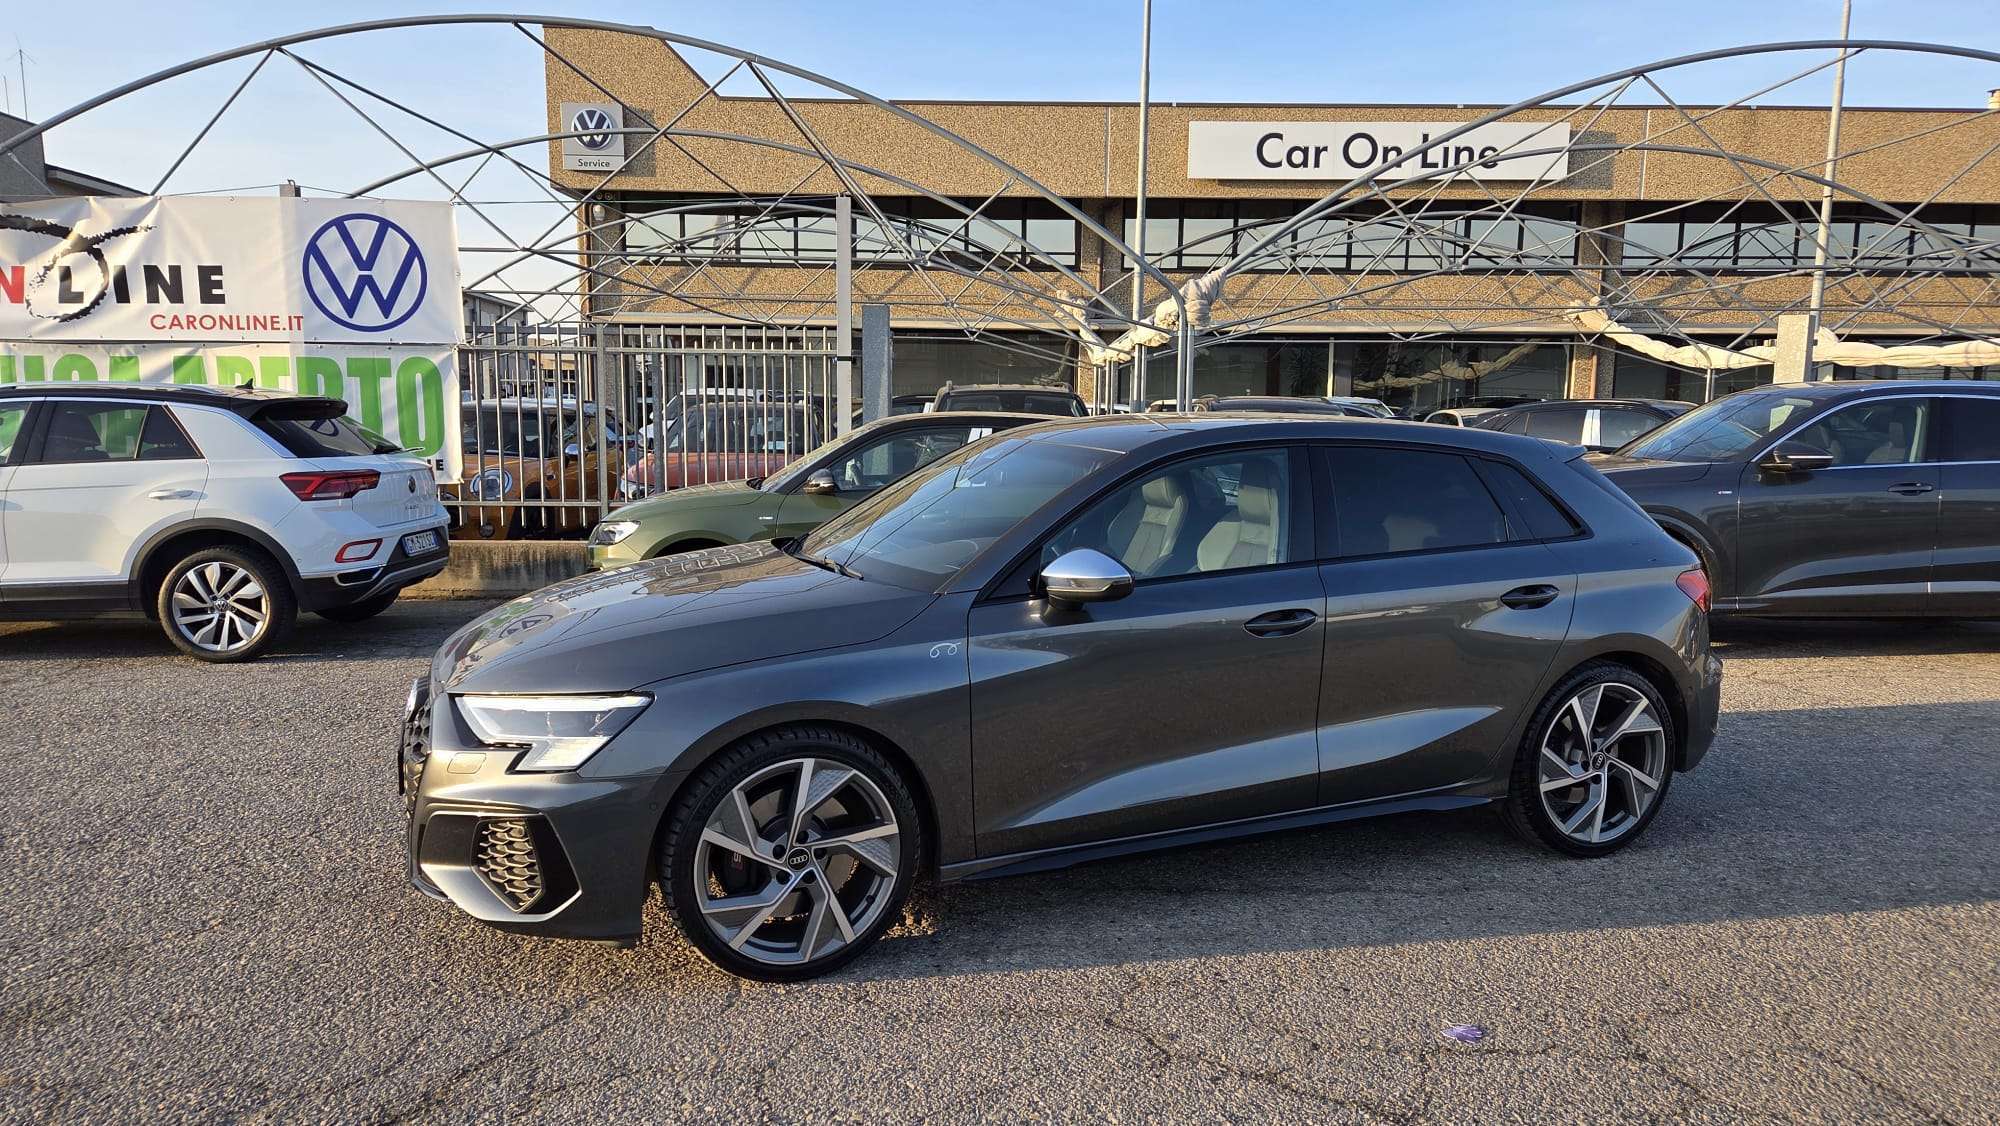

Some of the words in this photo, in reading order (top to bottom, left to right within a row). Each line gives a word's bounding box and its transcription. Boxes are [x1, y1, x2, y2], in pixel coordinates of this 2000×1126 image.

[578, 158, 610, 167] Service
[1256, 132, 1328, 169] Car
[1342, 132, 1403, 169] On
[1421, 133, 1499, 169] Line
[57, 264, 227, 305] LINE
[150, 313, 304, 331] CARONLINE.IT
